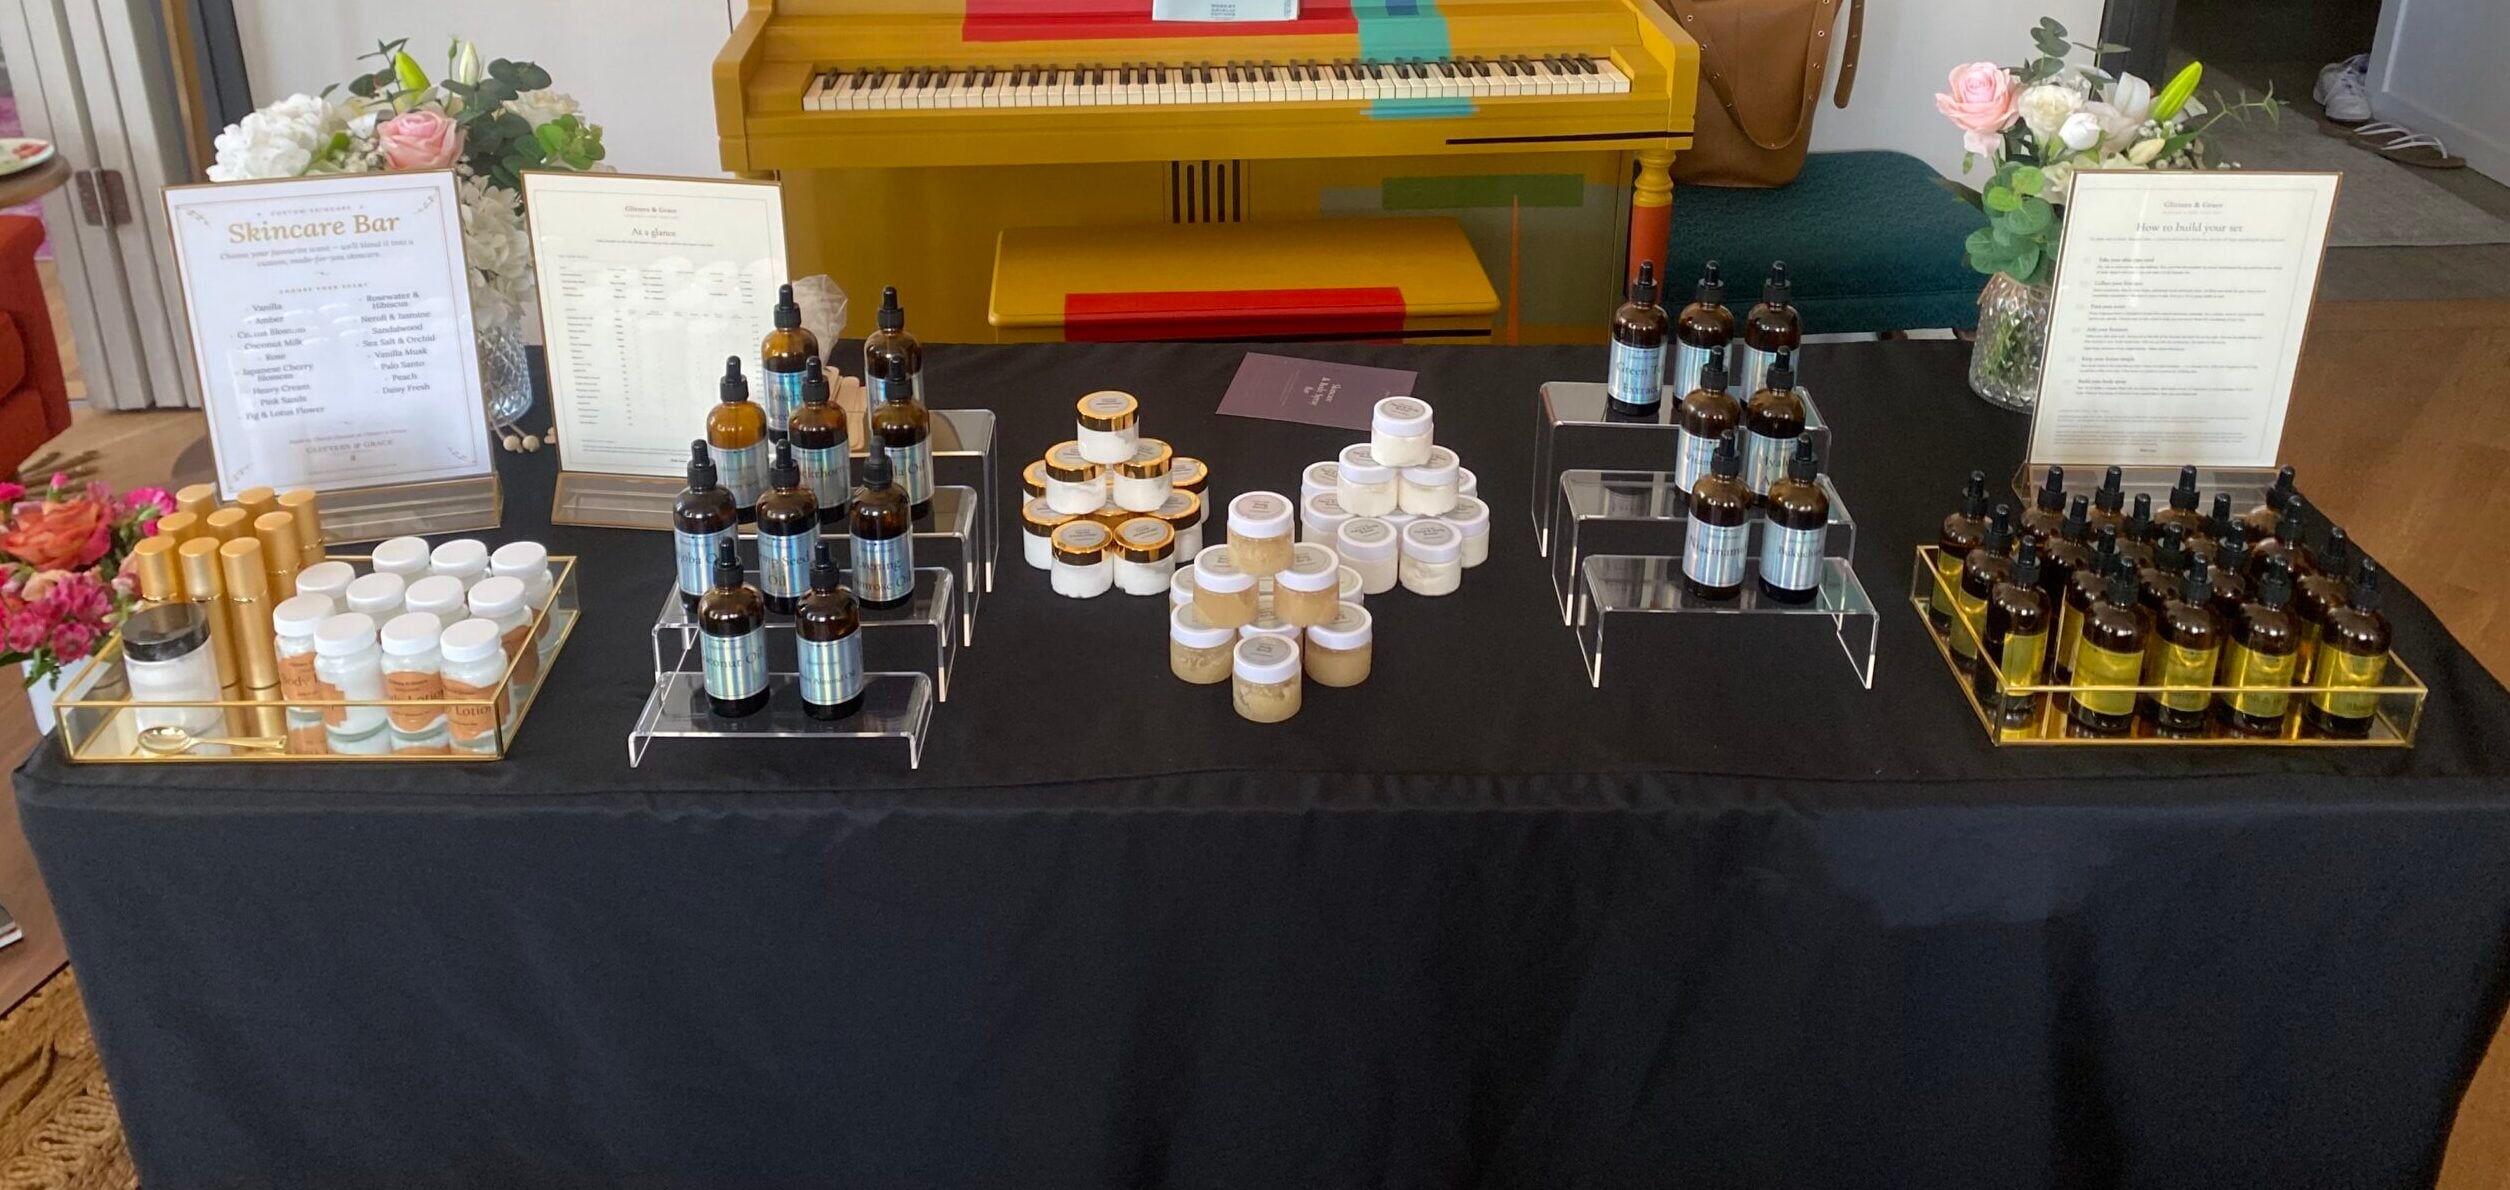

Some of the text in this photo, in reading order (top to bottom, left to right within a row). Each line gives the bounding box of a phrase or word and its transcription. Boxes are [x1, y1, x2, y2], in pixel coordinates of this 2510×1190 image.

[228, 214, 400, 244] Skincare Bar
[632, 227, 642, 236] At
[651, 228, 676, 238] glance
[2136, 222, 2243, 236] How to build your set
[366, 292, 410, 302] Rosewater
[252, 303, 282, 312] Vanilla
[372, 301, 409, 309] Hibiscus
[256, 316, 284, 324] Amber
[361, 314, 387, 323] Neroli
[398, 311, 431, 320] Jasmine
[372, 324, 423, 334] Sandalwood
[244, 338, 302, 350] Coconut Milk
[380, 338, 395, 346] Salt
[406, 334, 435, 344] Orchid
[265, 353, 286, 361] Rose
[374, 347, 428, 359] Vanilla Musk
[242, 363, 313, 377] Japanese Cherry
[381, 360, 425, 370] Palo Santo
[1617, 361, 1648, 376] Green
[257, 373, 294, 382] Blossom
[392, 373, 418, 381] Peach
[281, 384, 310, 392] Cream
[382, 383, 430, 395] Daisy Fresh
[260, 396, 307, 406] Pink Sands
[296, 406, 325, 415] Flower
[768, 574, 787, 587] Oil
[455, 704, 491, 717] Lotion
